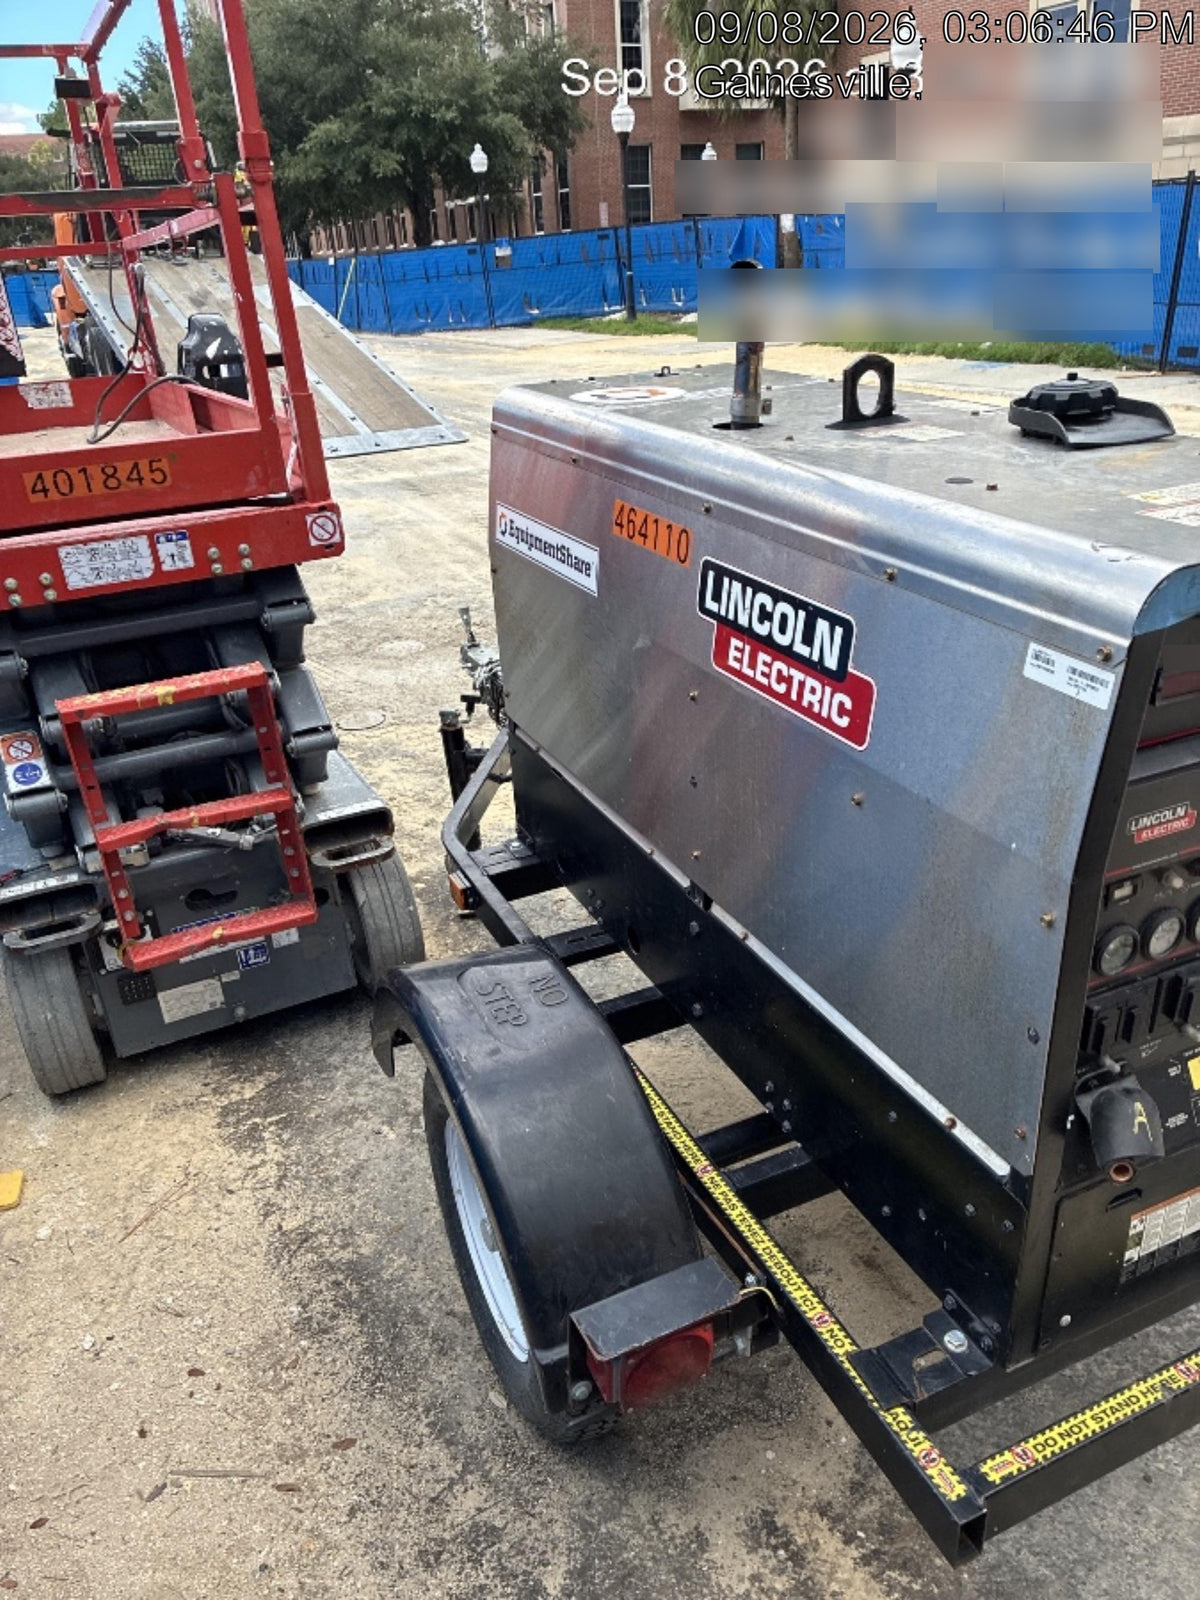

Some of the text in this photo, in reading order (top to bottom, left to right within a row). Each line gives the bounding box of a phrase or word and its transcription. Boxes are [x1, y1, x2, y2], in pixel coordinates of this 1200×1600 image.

[30, 457, 168, 498] 401845
[508, 517, 592, 579] EquipmentShare
[614, 502, 690, 565] 464110
[704, 570, 844, 672] LINCOLN
[726, 636, 853, 730] ELECTRIC
[1130, 804, 1187, 831] LINCOLN
[1141, 818, 1189, 839] ELECTRIC
[475, 982, 528, 1027] STEP
[528, 973, 569, 1007] NO
[762, 1246, 806, 1292] DEBOUT
[801, 1294, 817, 1311] ICI
[826, 1328, 845, 1349] NO
[1032, 1373, 1182, 1455] DO NOT STAND HERE
